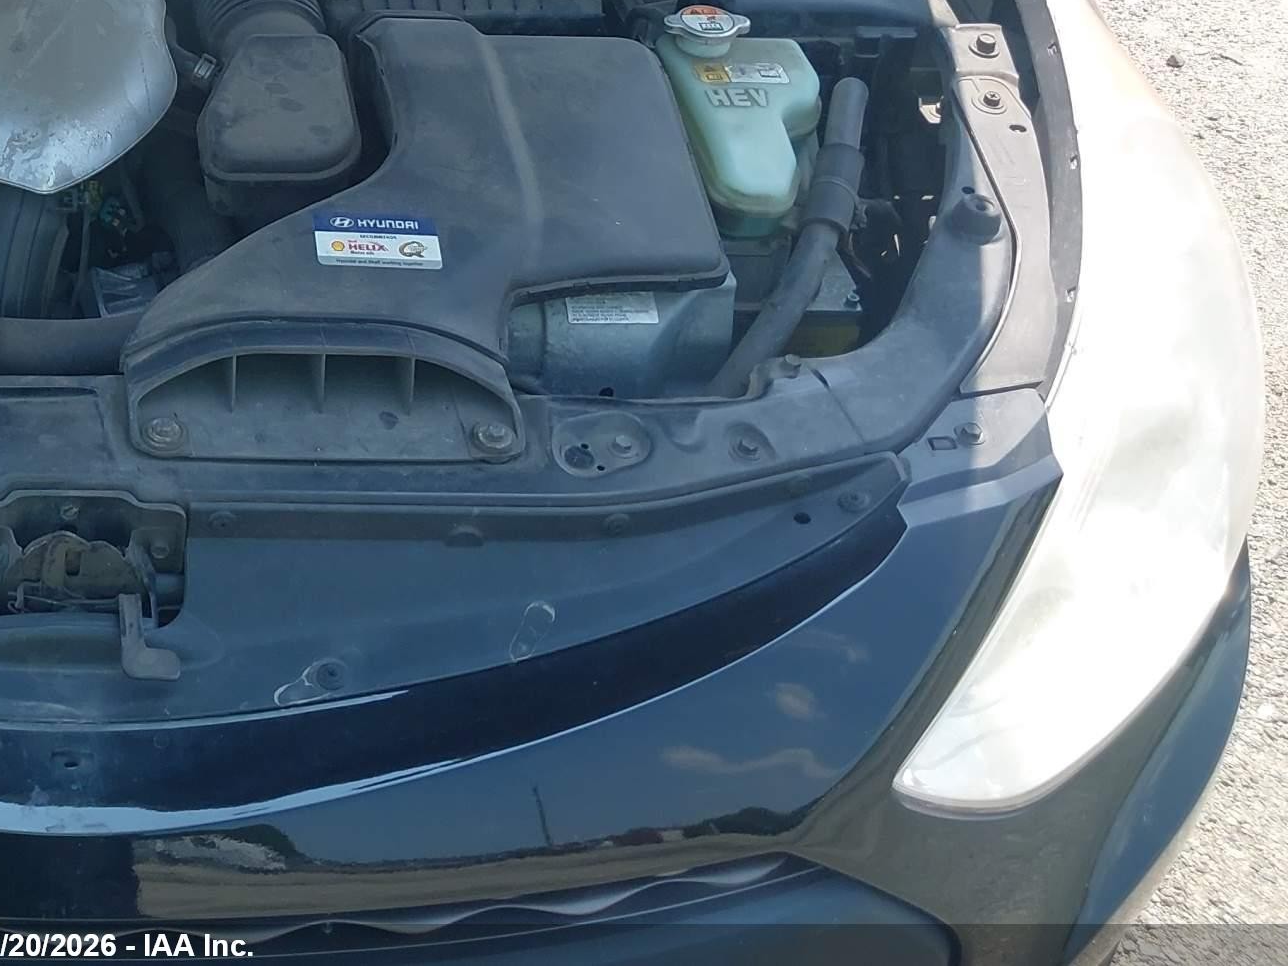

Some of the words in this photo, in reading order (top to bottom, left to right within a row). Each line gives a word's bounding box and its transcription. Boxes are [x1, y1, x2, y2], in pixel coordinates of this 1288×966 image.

[705, 88, 769, 107] HEV
[357, 218, 419, 230] HYUNDAI
[347, 242, 388, 253] HELIX
